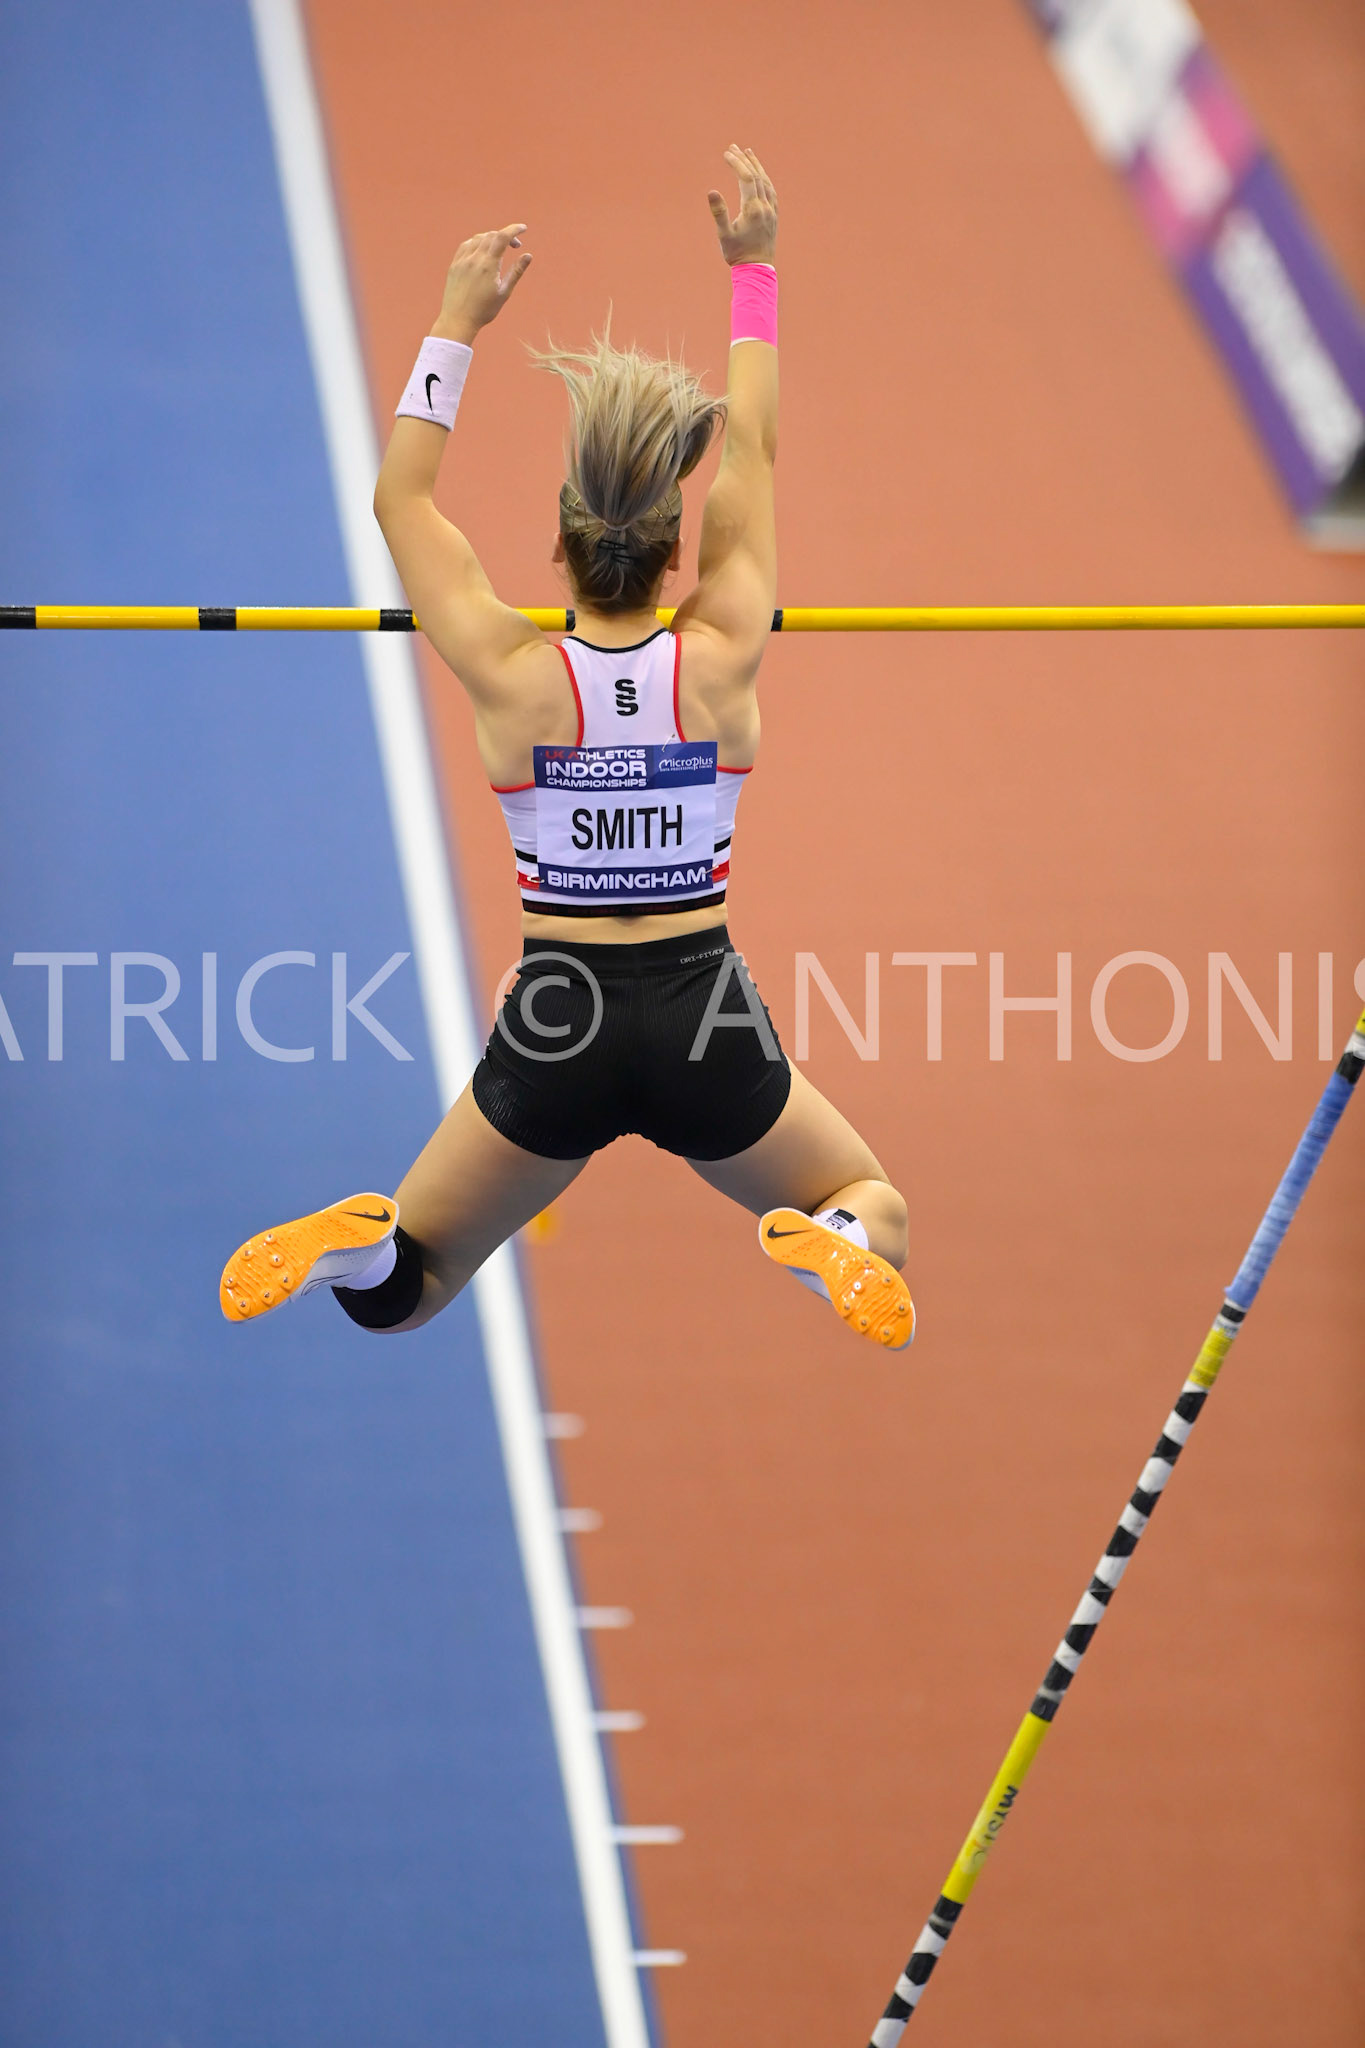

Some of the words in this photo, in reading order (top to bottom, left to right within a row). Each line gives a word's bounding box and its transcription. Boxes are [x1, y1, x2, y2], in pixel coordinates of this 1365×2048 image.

[545, 749, 565, 760] UK
[567, 749, 646, 761] ATHLETICS
[545, 761, 647, 778] INDOOR
[546, 777, 647, 788] CHAMPIONSHIPS
[571, 804, 683, 851] SMITH
[547, 865, 707, 891] BIRMINGHAM
